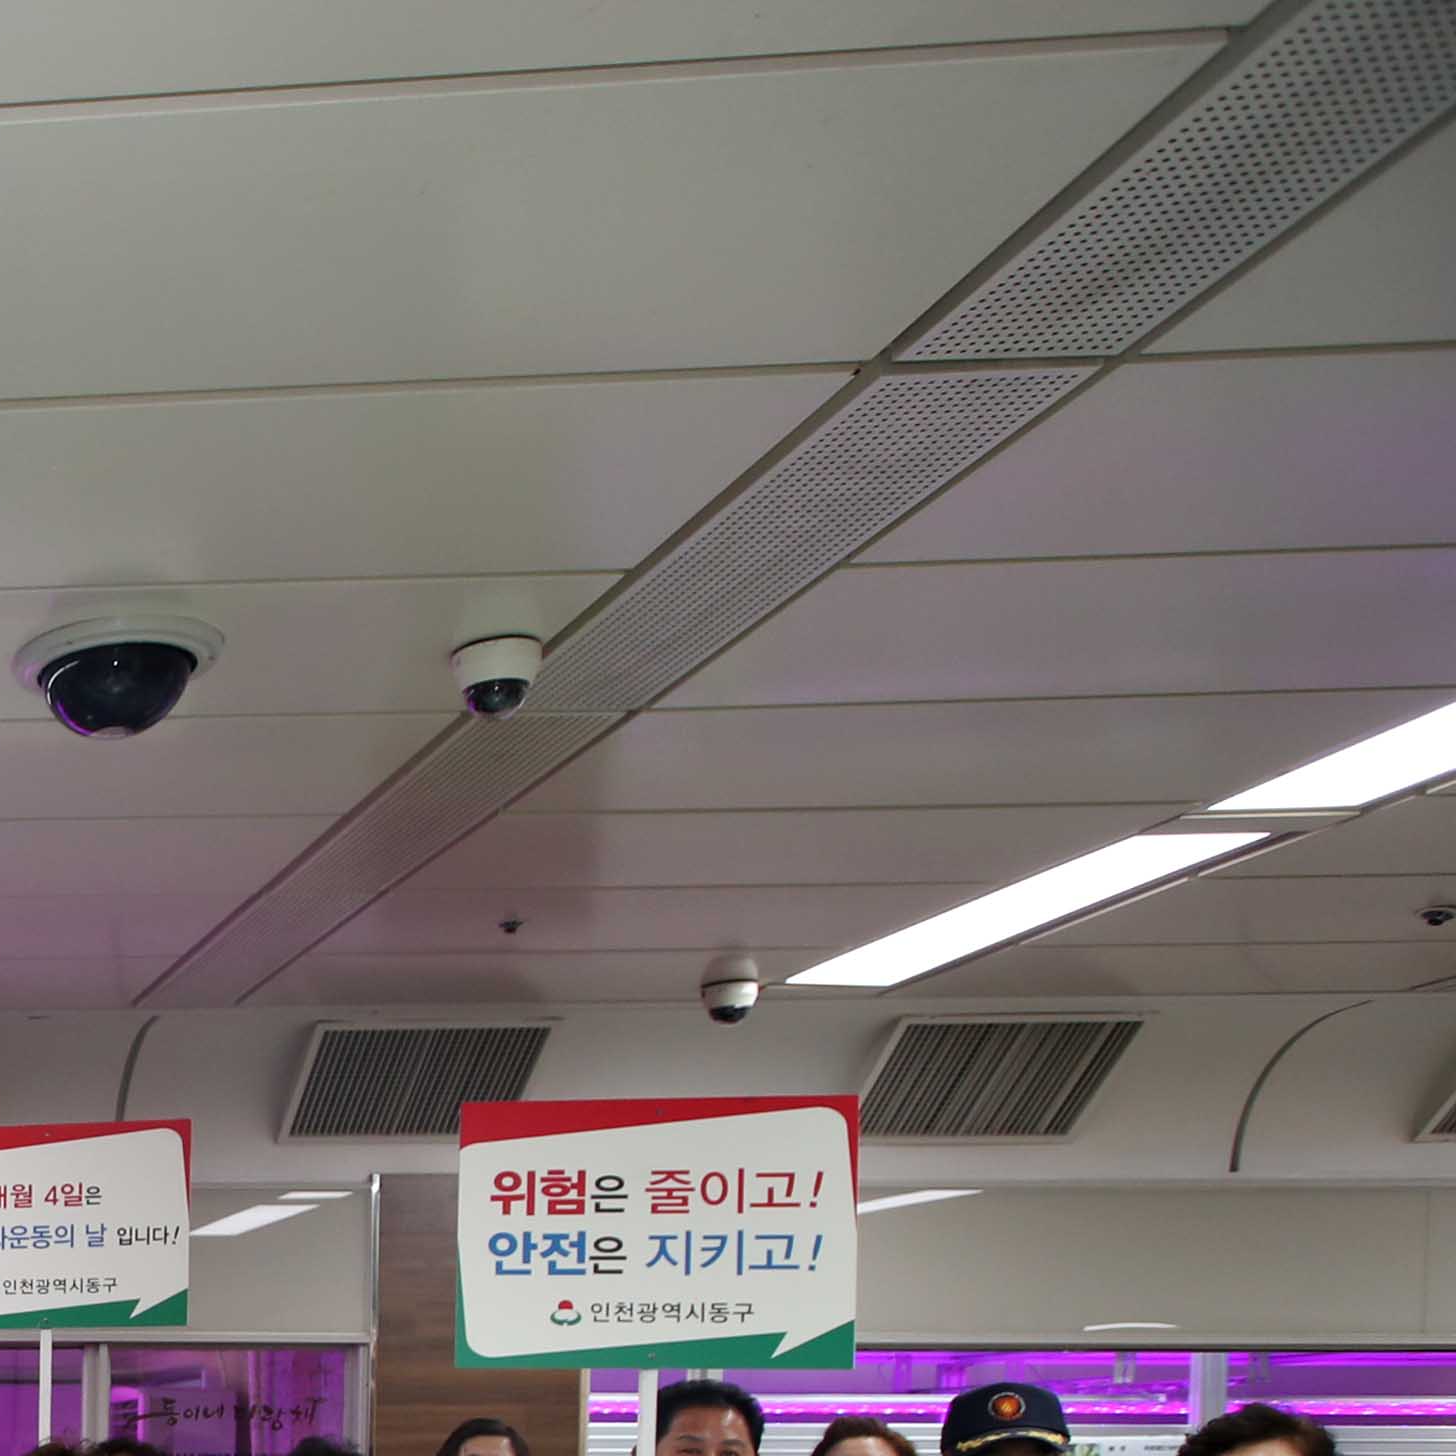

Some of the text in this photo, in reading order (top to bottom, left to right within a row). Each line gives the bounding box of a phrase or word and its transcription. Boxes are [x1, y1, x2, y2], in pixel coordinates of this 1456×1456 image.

[44, 1182, 103, 1206] 4일은
[489, 1168, 824, 1216] 위험은 줄이고!
[85, 1224, 107, 1247] 날
[116, 1226, 180, 1246] 입니다!
[488, 1230, 823, 1276] 안전은 지키고!
[2, 1277, 118, 1295] 인천광역시동구
[590, 1302, 754, 1325] 인천광역시동구
